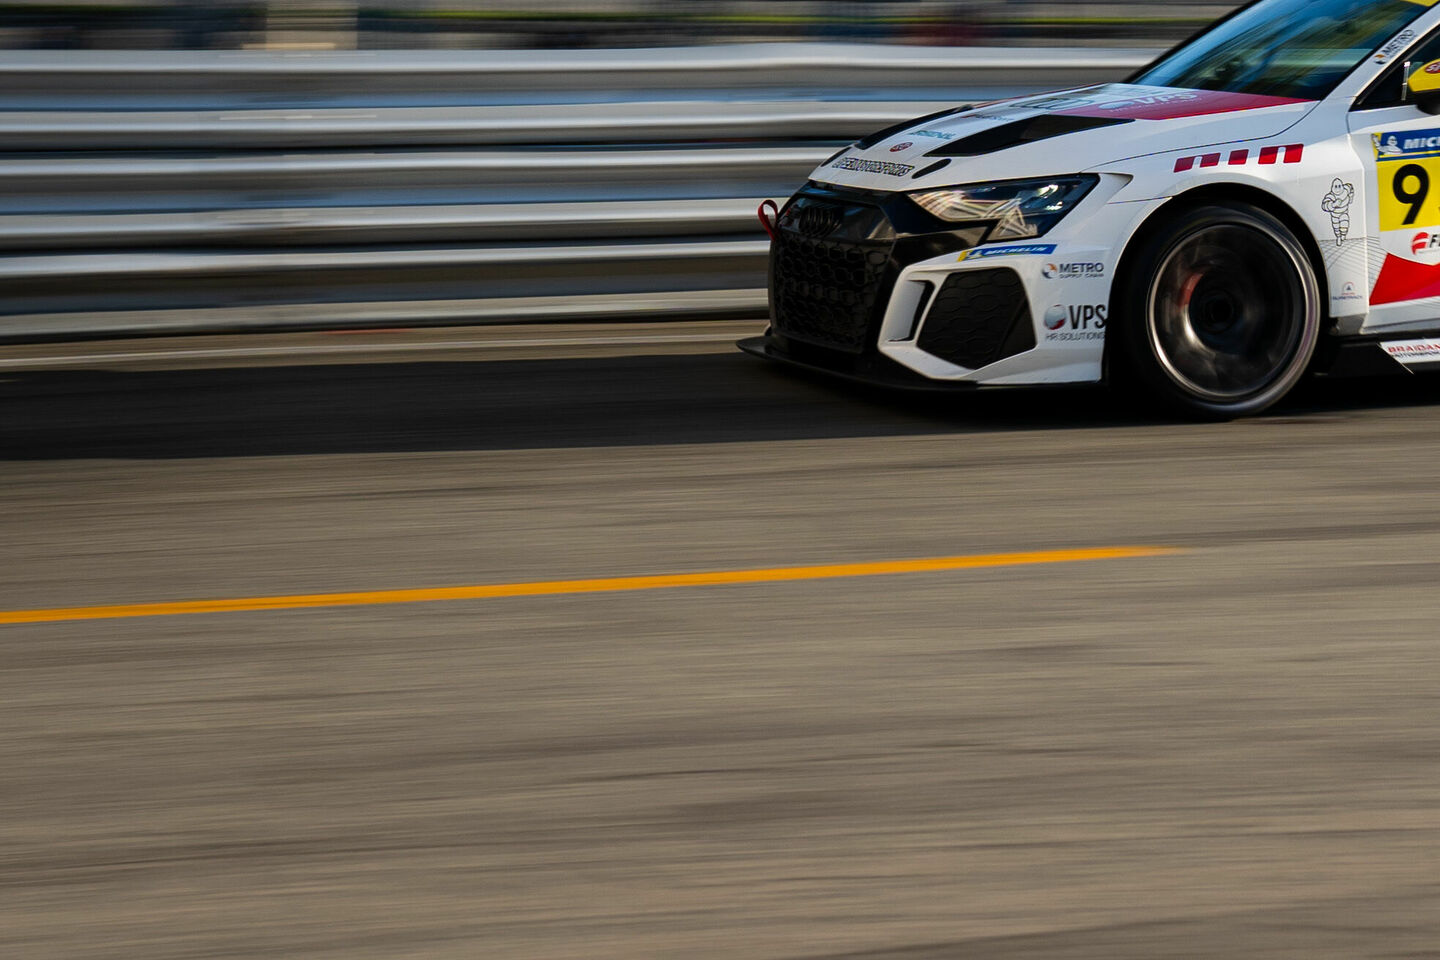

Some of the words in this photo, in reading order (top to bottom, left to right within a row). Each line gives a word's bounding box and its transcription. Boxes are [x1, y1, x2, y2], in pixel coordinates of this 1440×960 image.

[983, 246, 1049, 256] MICHELIN
[1059, 262, 1104, 273] METRO
[1068, 304, 1107, 330] VPS
